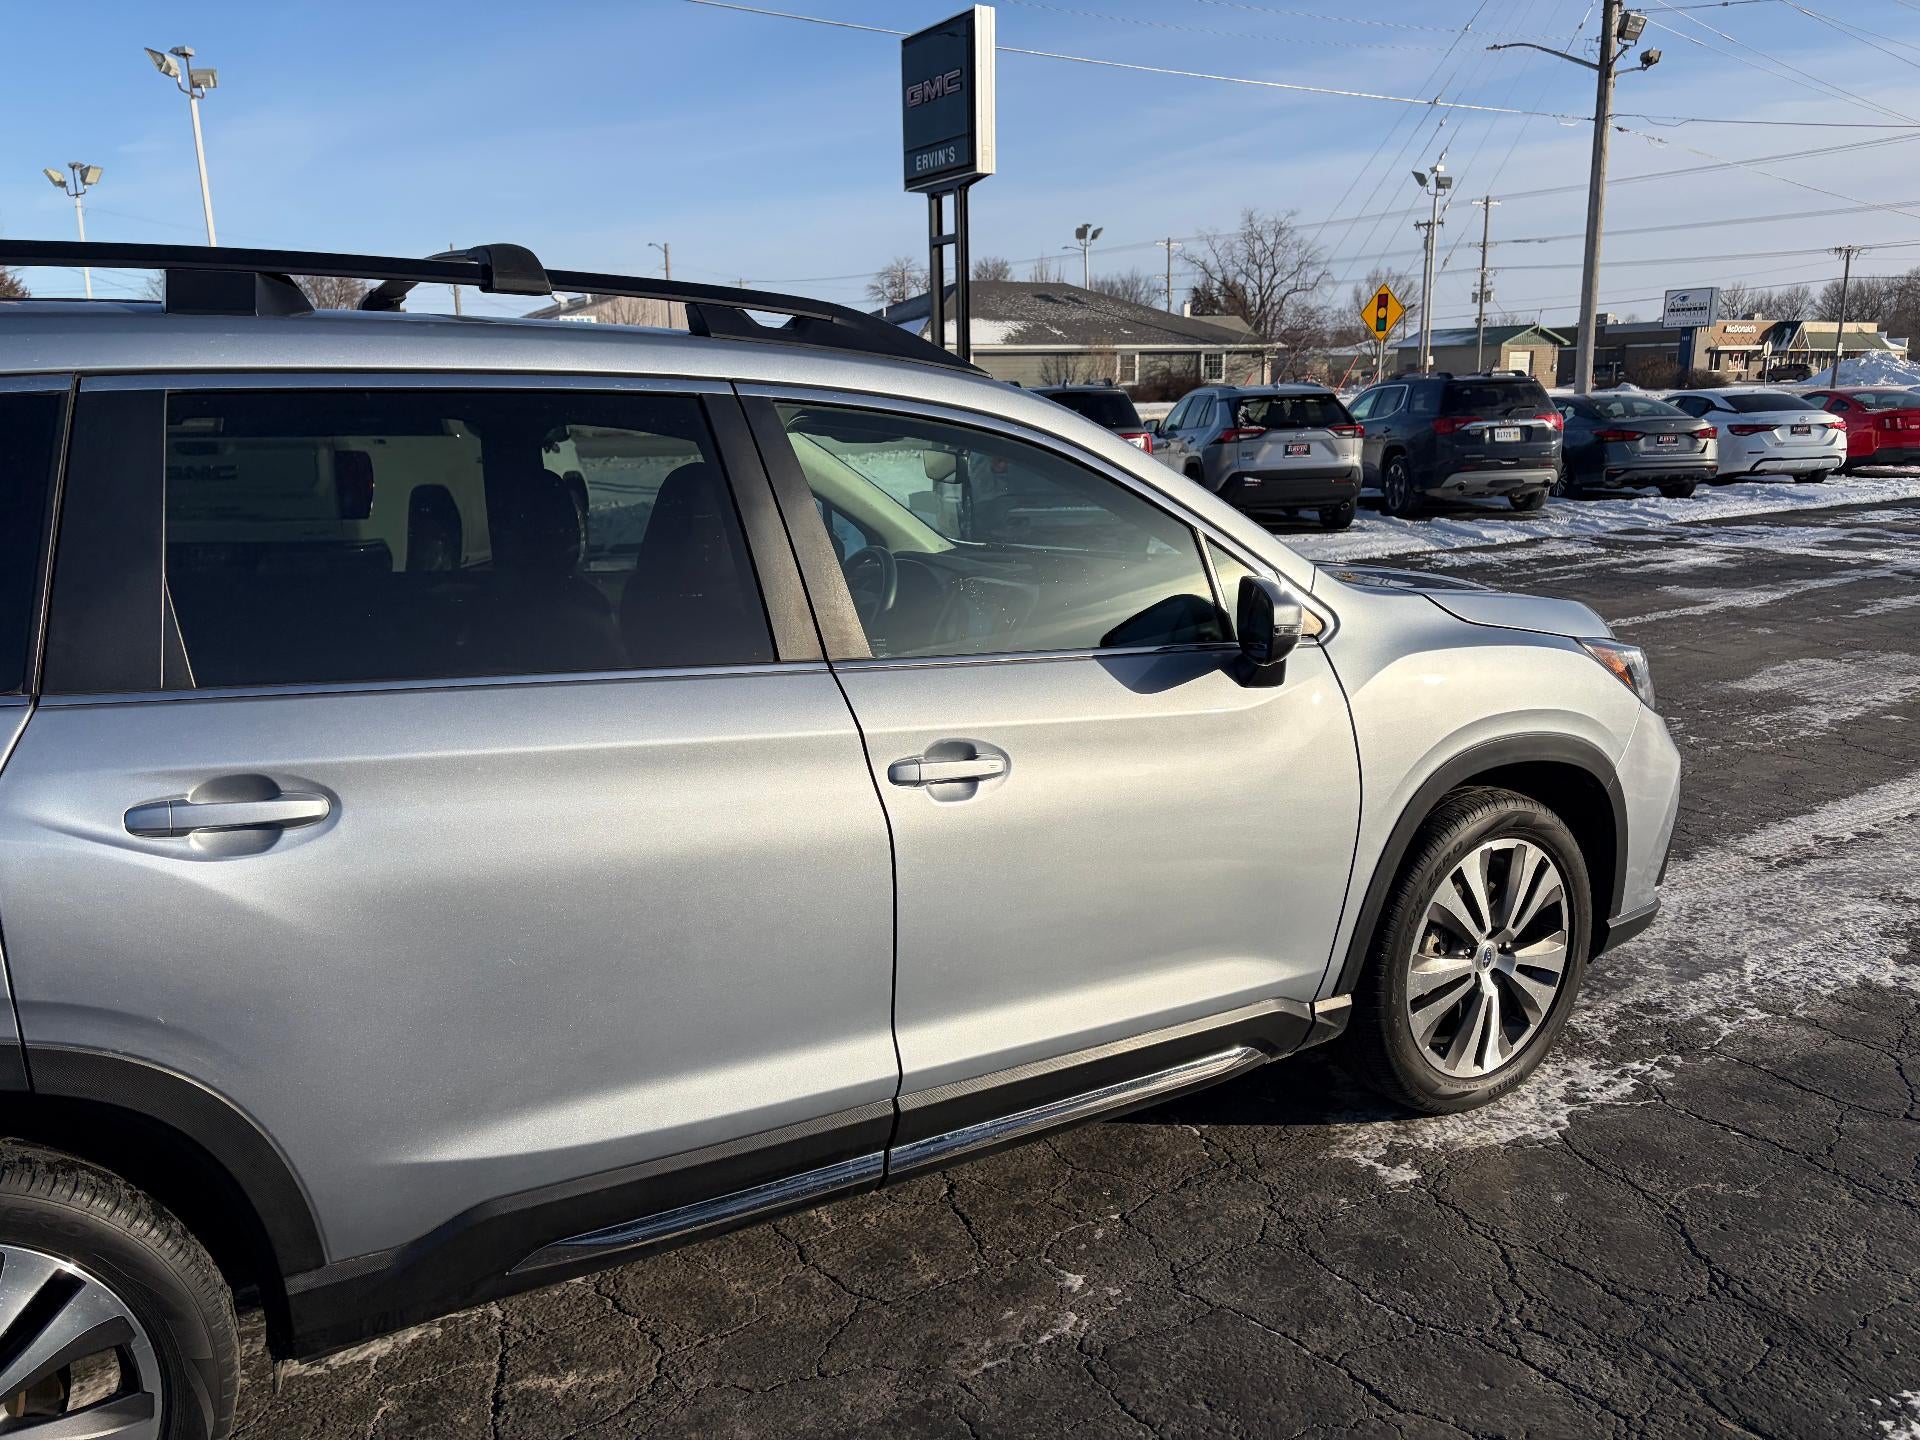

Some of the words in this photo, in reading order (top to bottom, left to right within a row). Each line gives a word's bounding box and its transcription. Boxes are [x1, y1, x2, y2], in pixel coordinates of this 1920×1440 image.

[907, 70, 961, 107] GMC
[916, 146, 956, 171] ERVIN'S
[1725, 324, 1757, 333] McDonald's
